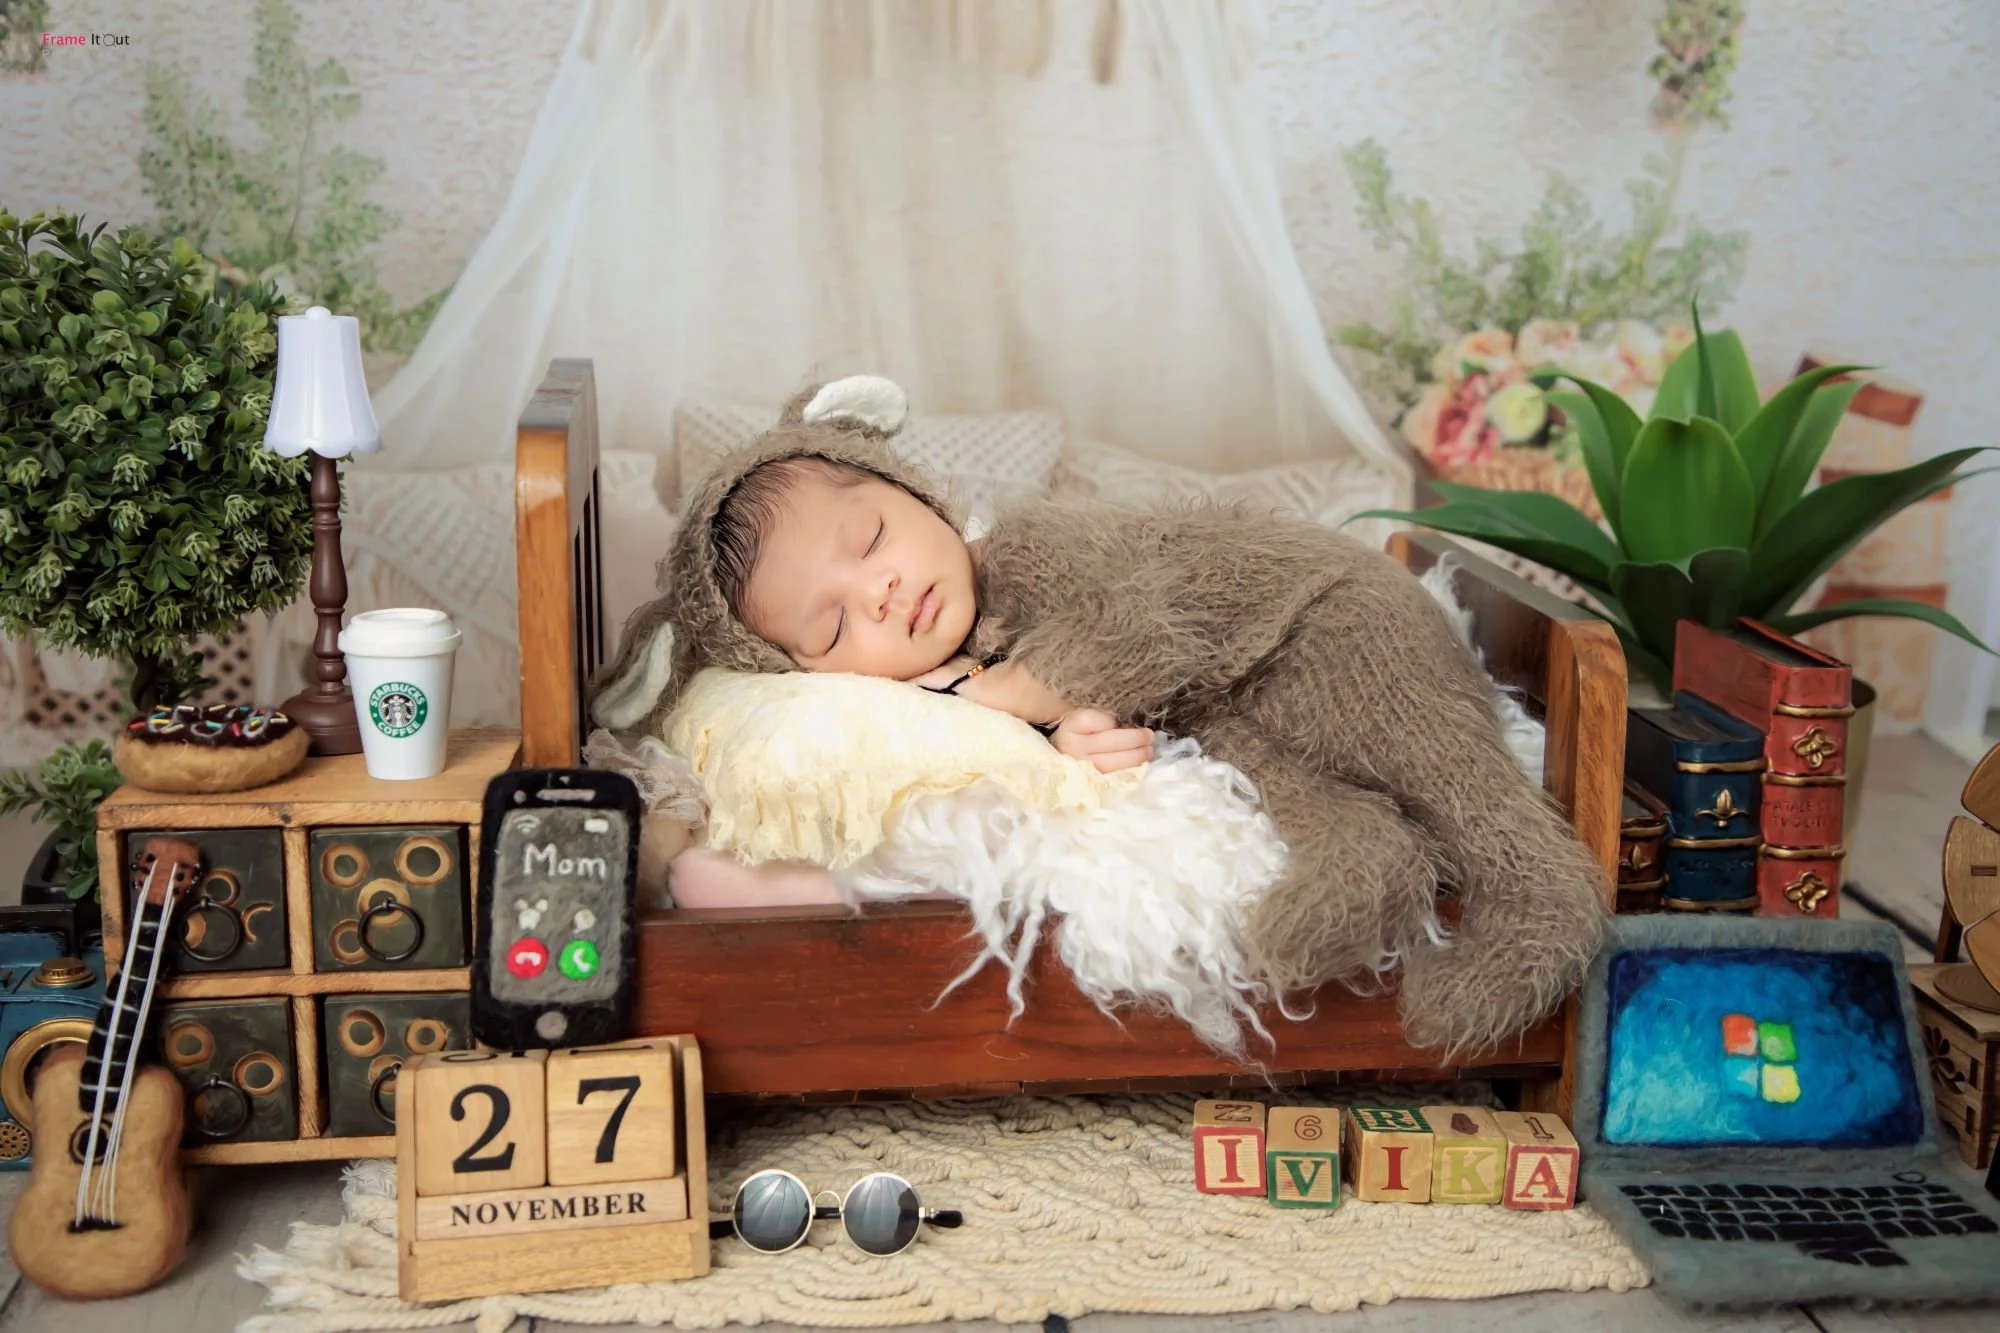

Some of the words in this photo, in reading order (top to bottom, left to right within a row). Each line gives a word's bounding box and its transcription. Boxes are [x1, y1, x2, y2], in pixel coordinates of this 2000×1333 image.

[370, 683, 425, 707] STARBUCKS
[378, 721, 421, 737] COFFEE
[523, 843, 606, 879] Mom
[450, 1192, 647, 1227] NOVEMBER
